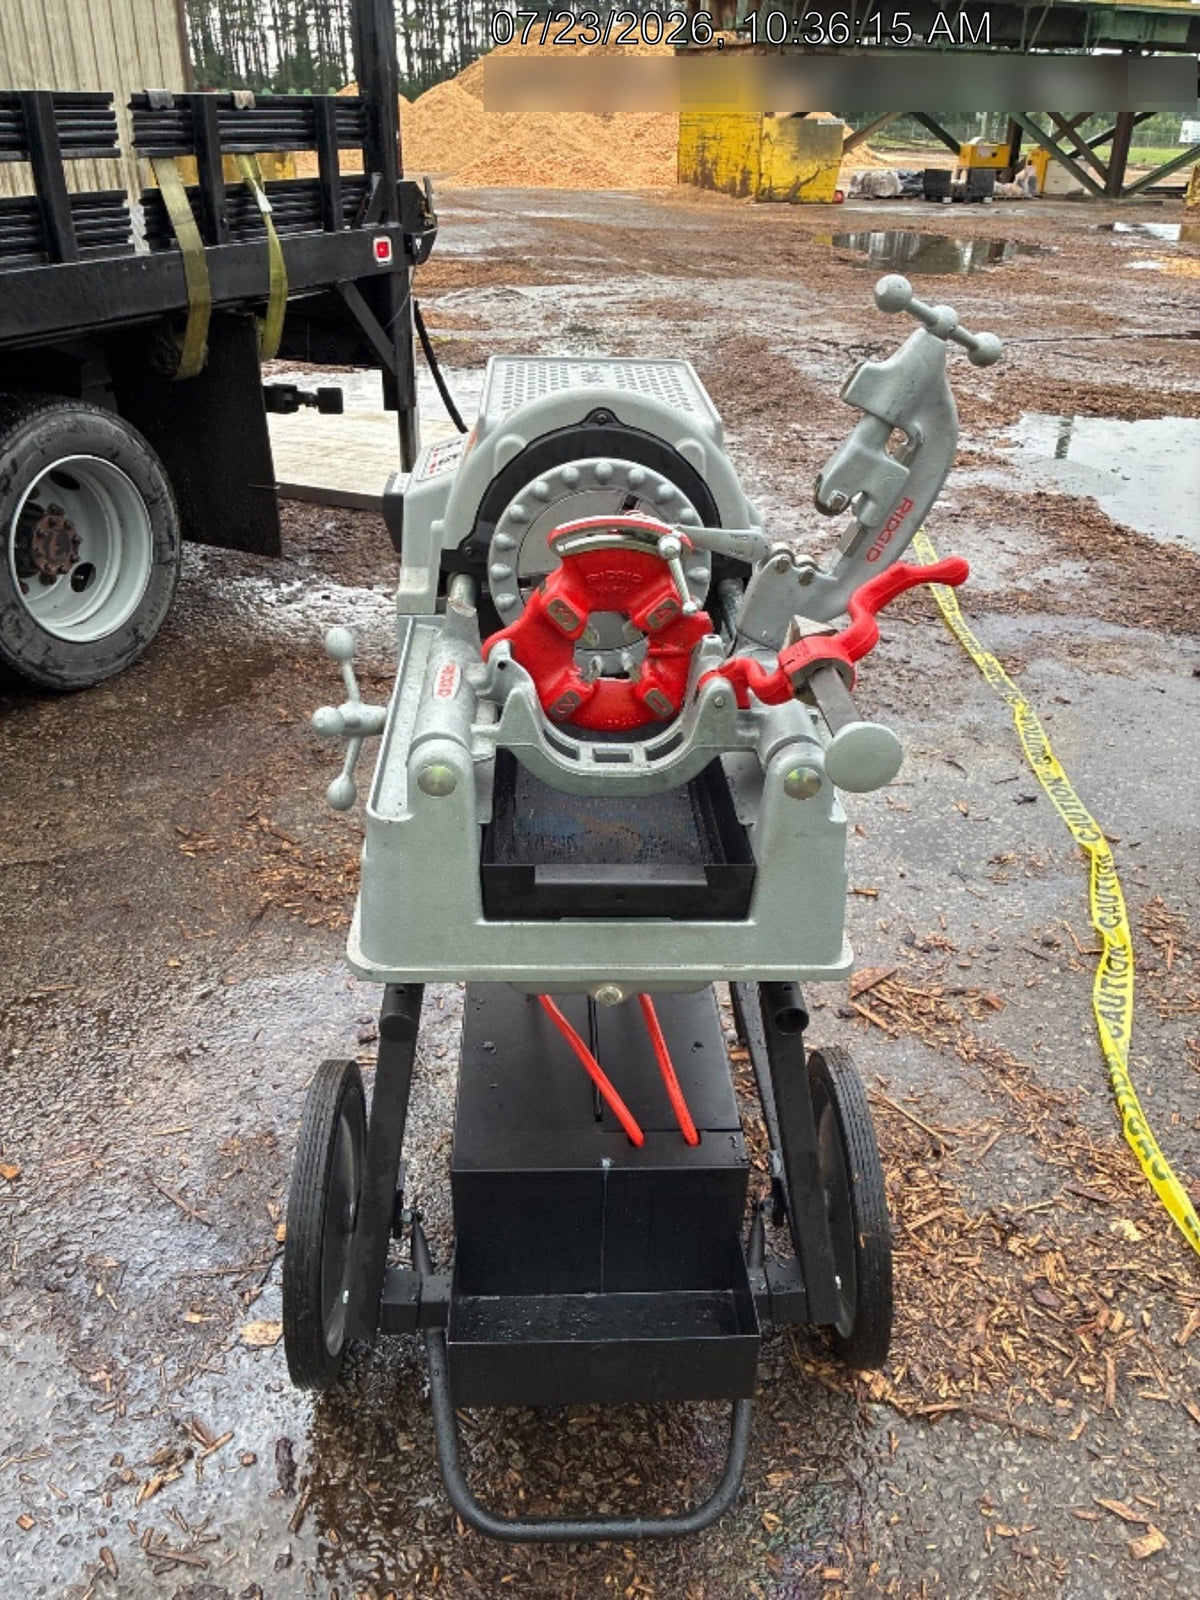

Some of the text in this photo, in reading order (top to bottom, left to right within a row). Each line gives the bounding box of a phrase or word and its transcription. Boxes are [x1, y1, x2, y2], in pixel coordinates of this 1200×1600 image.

[866, 496, 914, 563] RIDGID
[1048, 776, 1101, 842] CAUTION
[1098, 943, 1128, 1039] CAUTION
